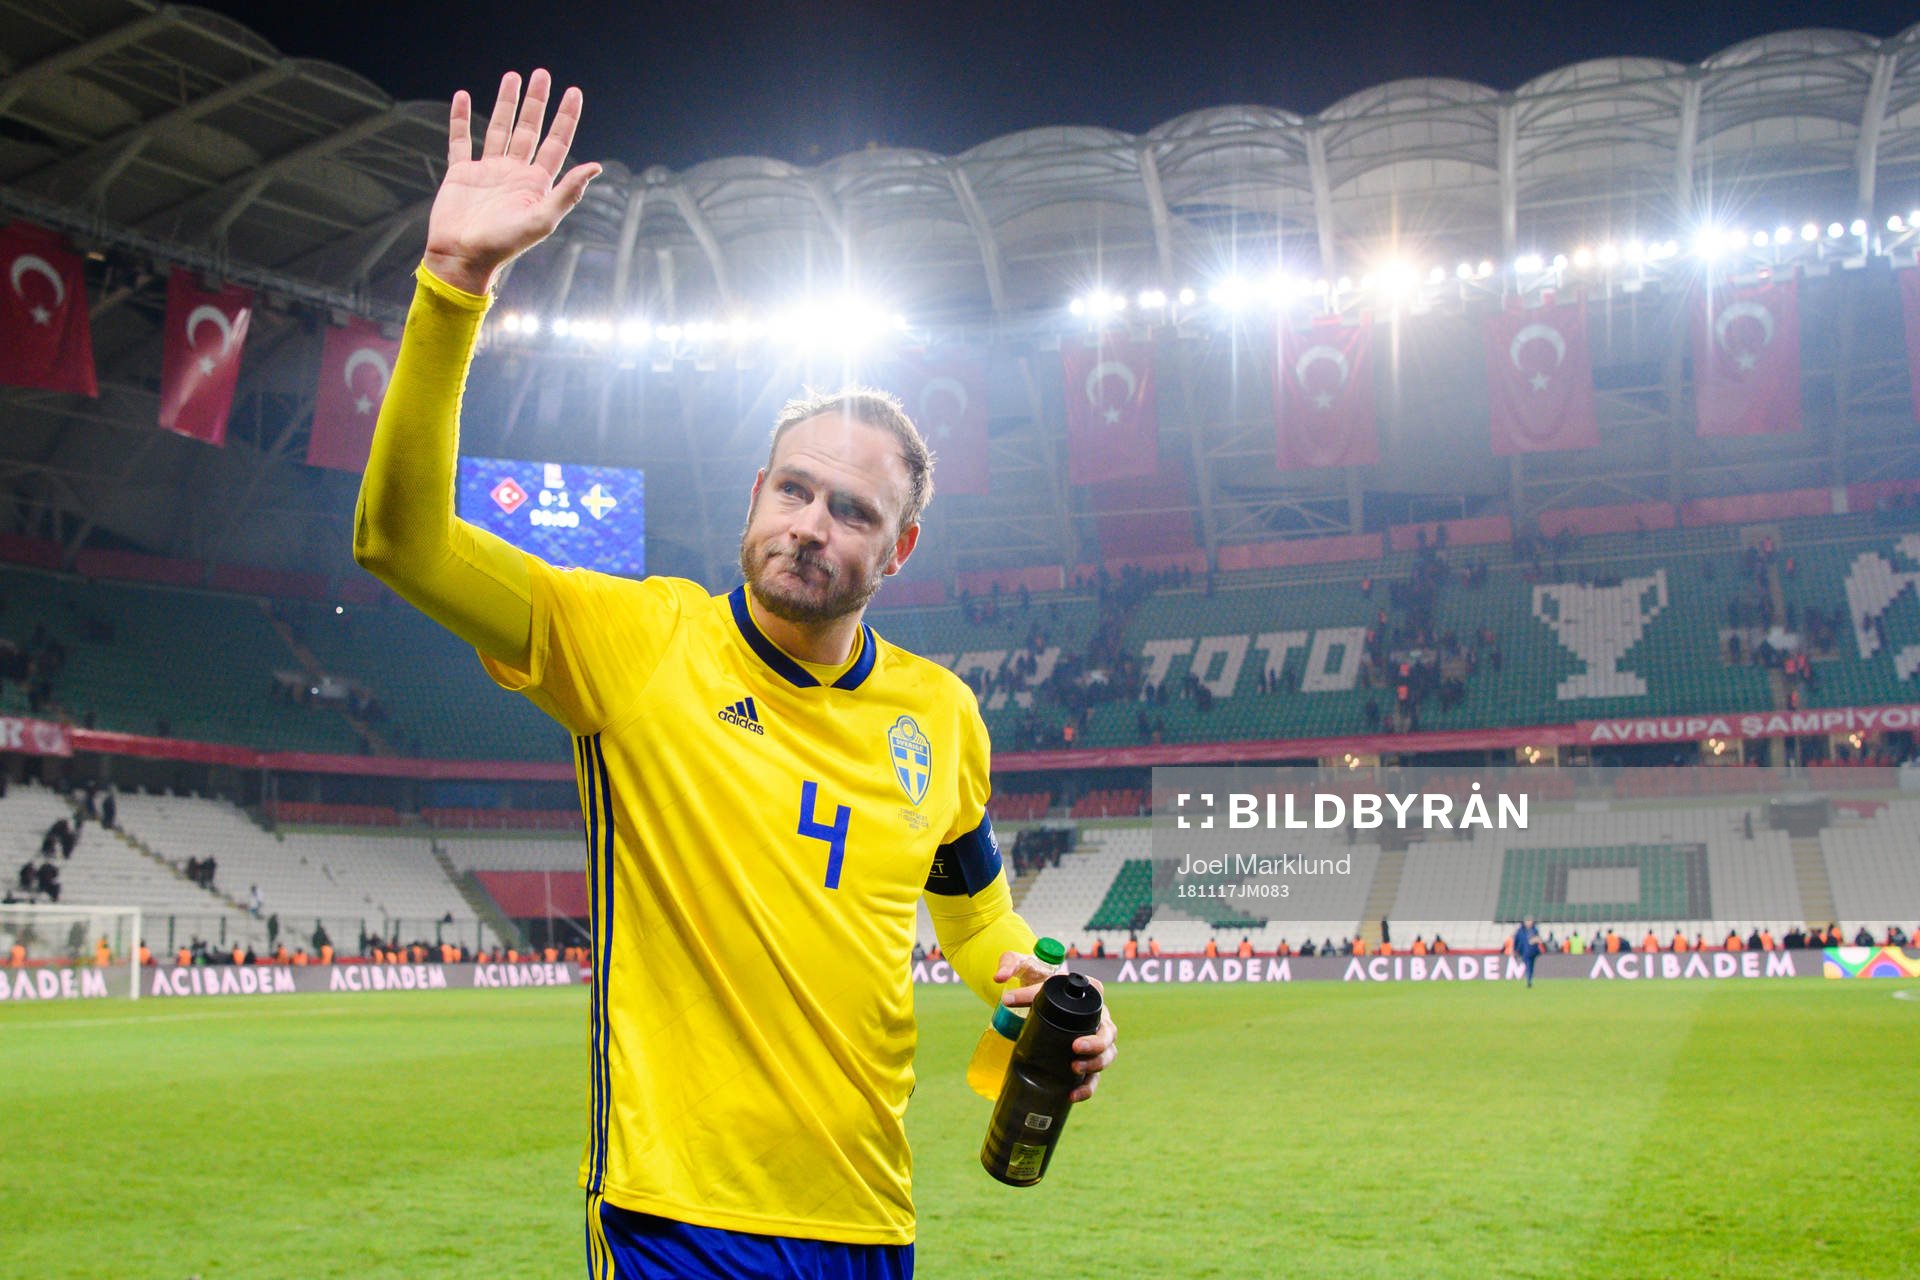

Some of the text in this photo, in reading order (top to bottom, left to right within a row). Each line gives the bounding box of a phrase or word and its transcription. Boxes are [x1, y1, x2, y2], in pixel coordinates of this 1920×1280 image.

[1140, 626, 1367, 703] TOTO
[718, 710, 764, 736] adidas
[1589, 719, 1731, 743] AVRUPA
[797, 780, 851, 890] 4
[151, 966, 296, 996] ACIBADEM
[330, 964, 447, 991] ACIBADEM
[473, 963, 571, 987] ACIBADEM
[1117, 959, 1292, 983] ACIBADEM
[1344, 956, 1526, 981] ACIBADEM
[1589, 951, 1798, 979] ACIBADEM
